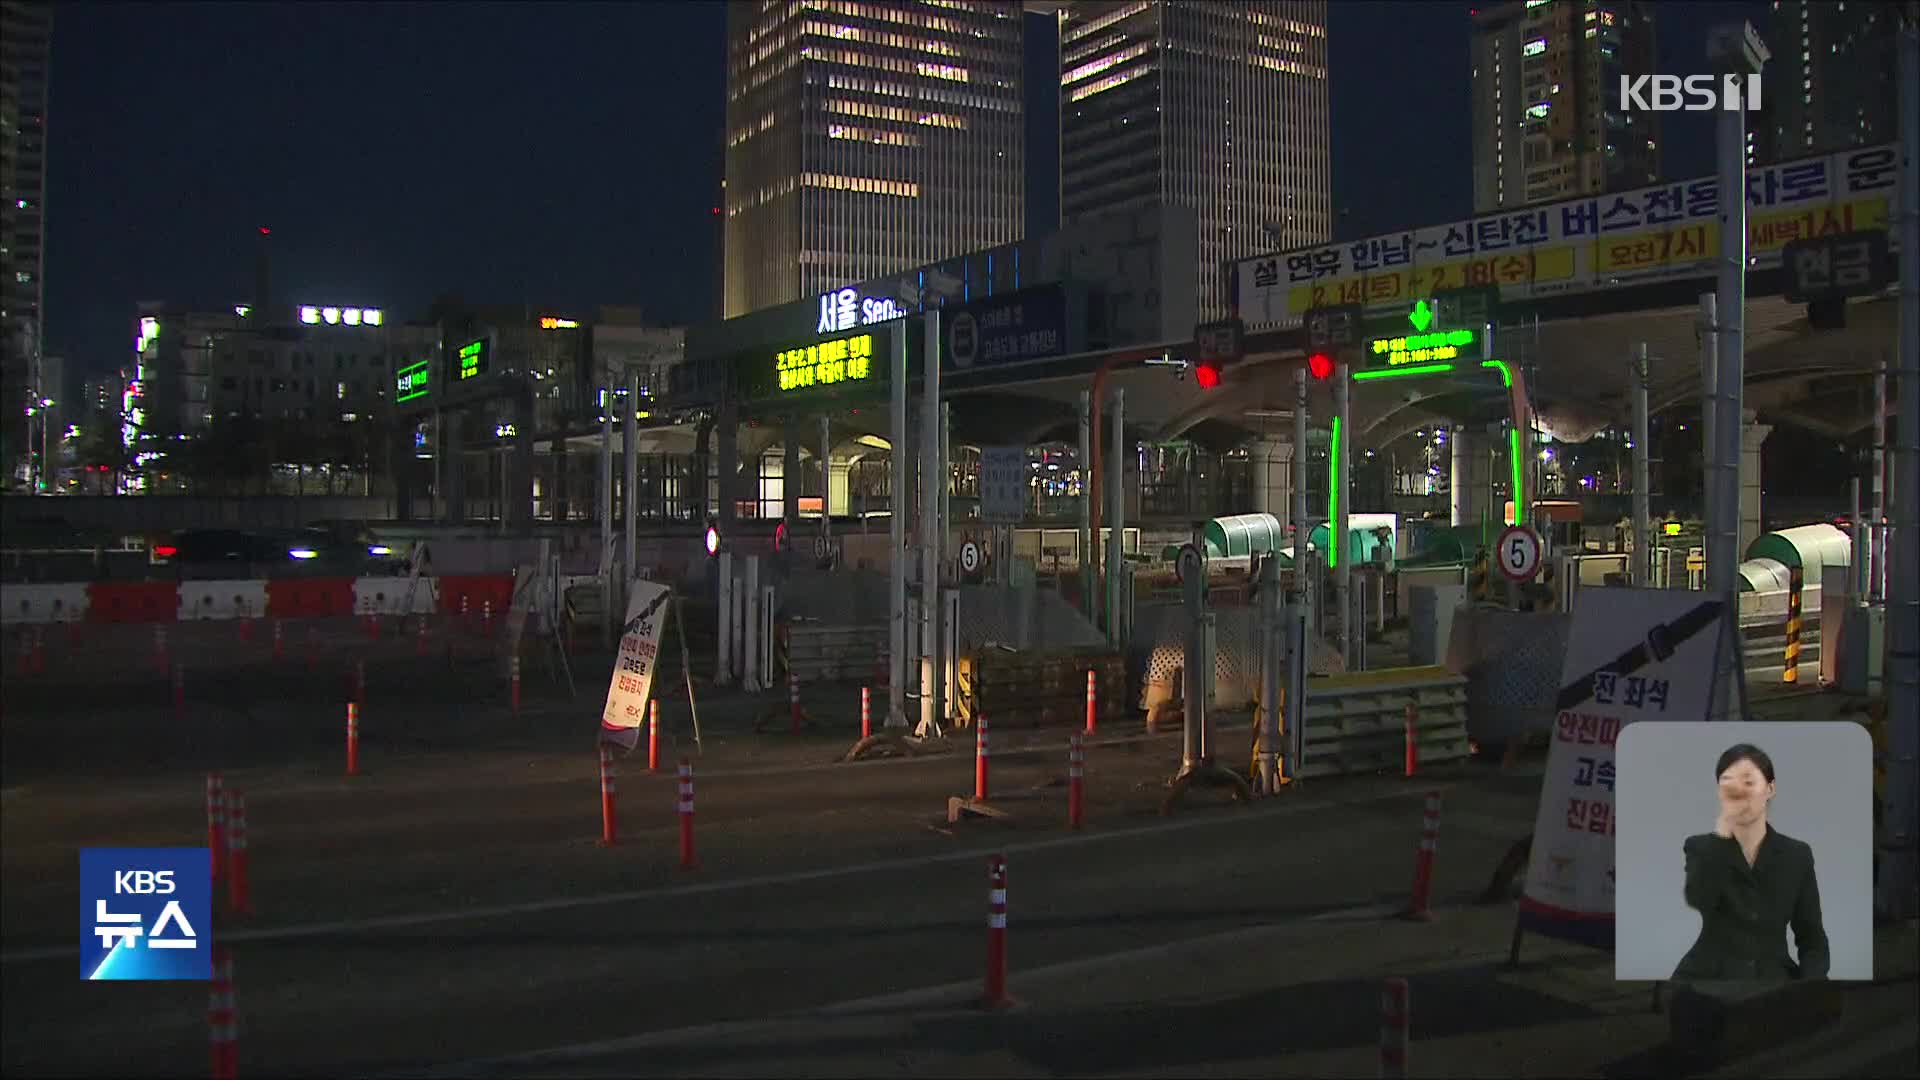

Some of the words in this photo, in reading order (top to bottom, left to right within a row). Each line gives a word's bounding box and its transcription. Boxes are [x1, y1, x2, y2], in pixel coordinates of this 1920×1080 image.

[1253, 260, 1279, 288] 설
[1286, 248, 1342, 281] 연휴
[1350, 211, 1549, 273] 한남~신탄진
[1610, 226, 1706, 269] 오전7시
[1794, 240, 1872, 289] 현금
[817, 288, 857, 334] 서울
[965, 547, 973, 567] 5
[1511, 539, 1526, 568] 5
[1595, 673, 1616, 705] 전
[1623, 676, 1670, 712] 좌석
